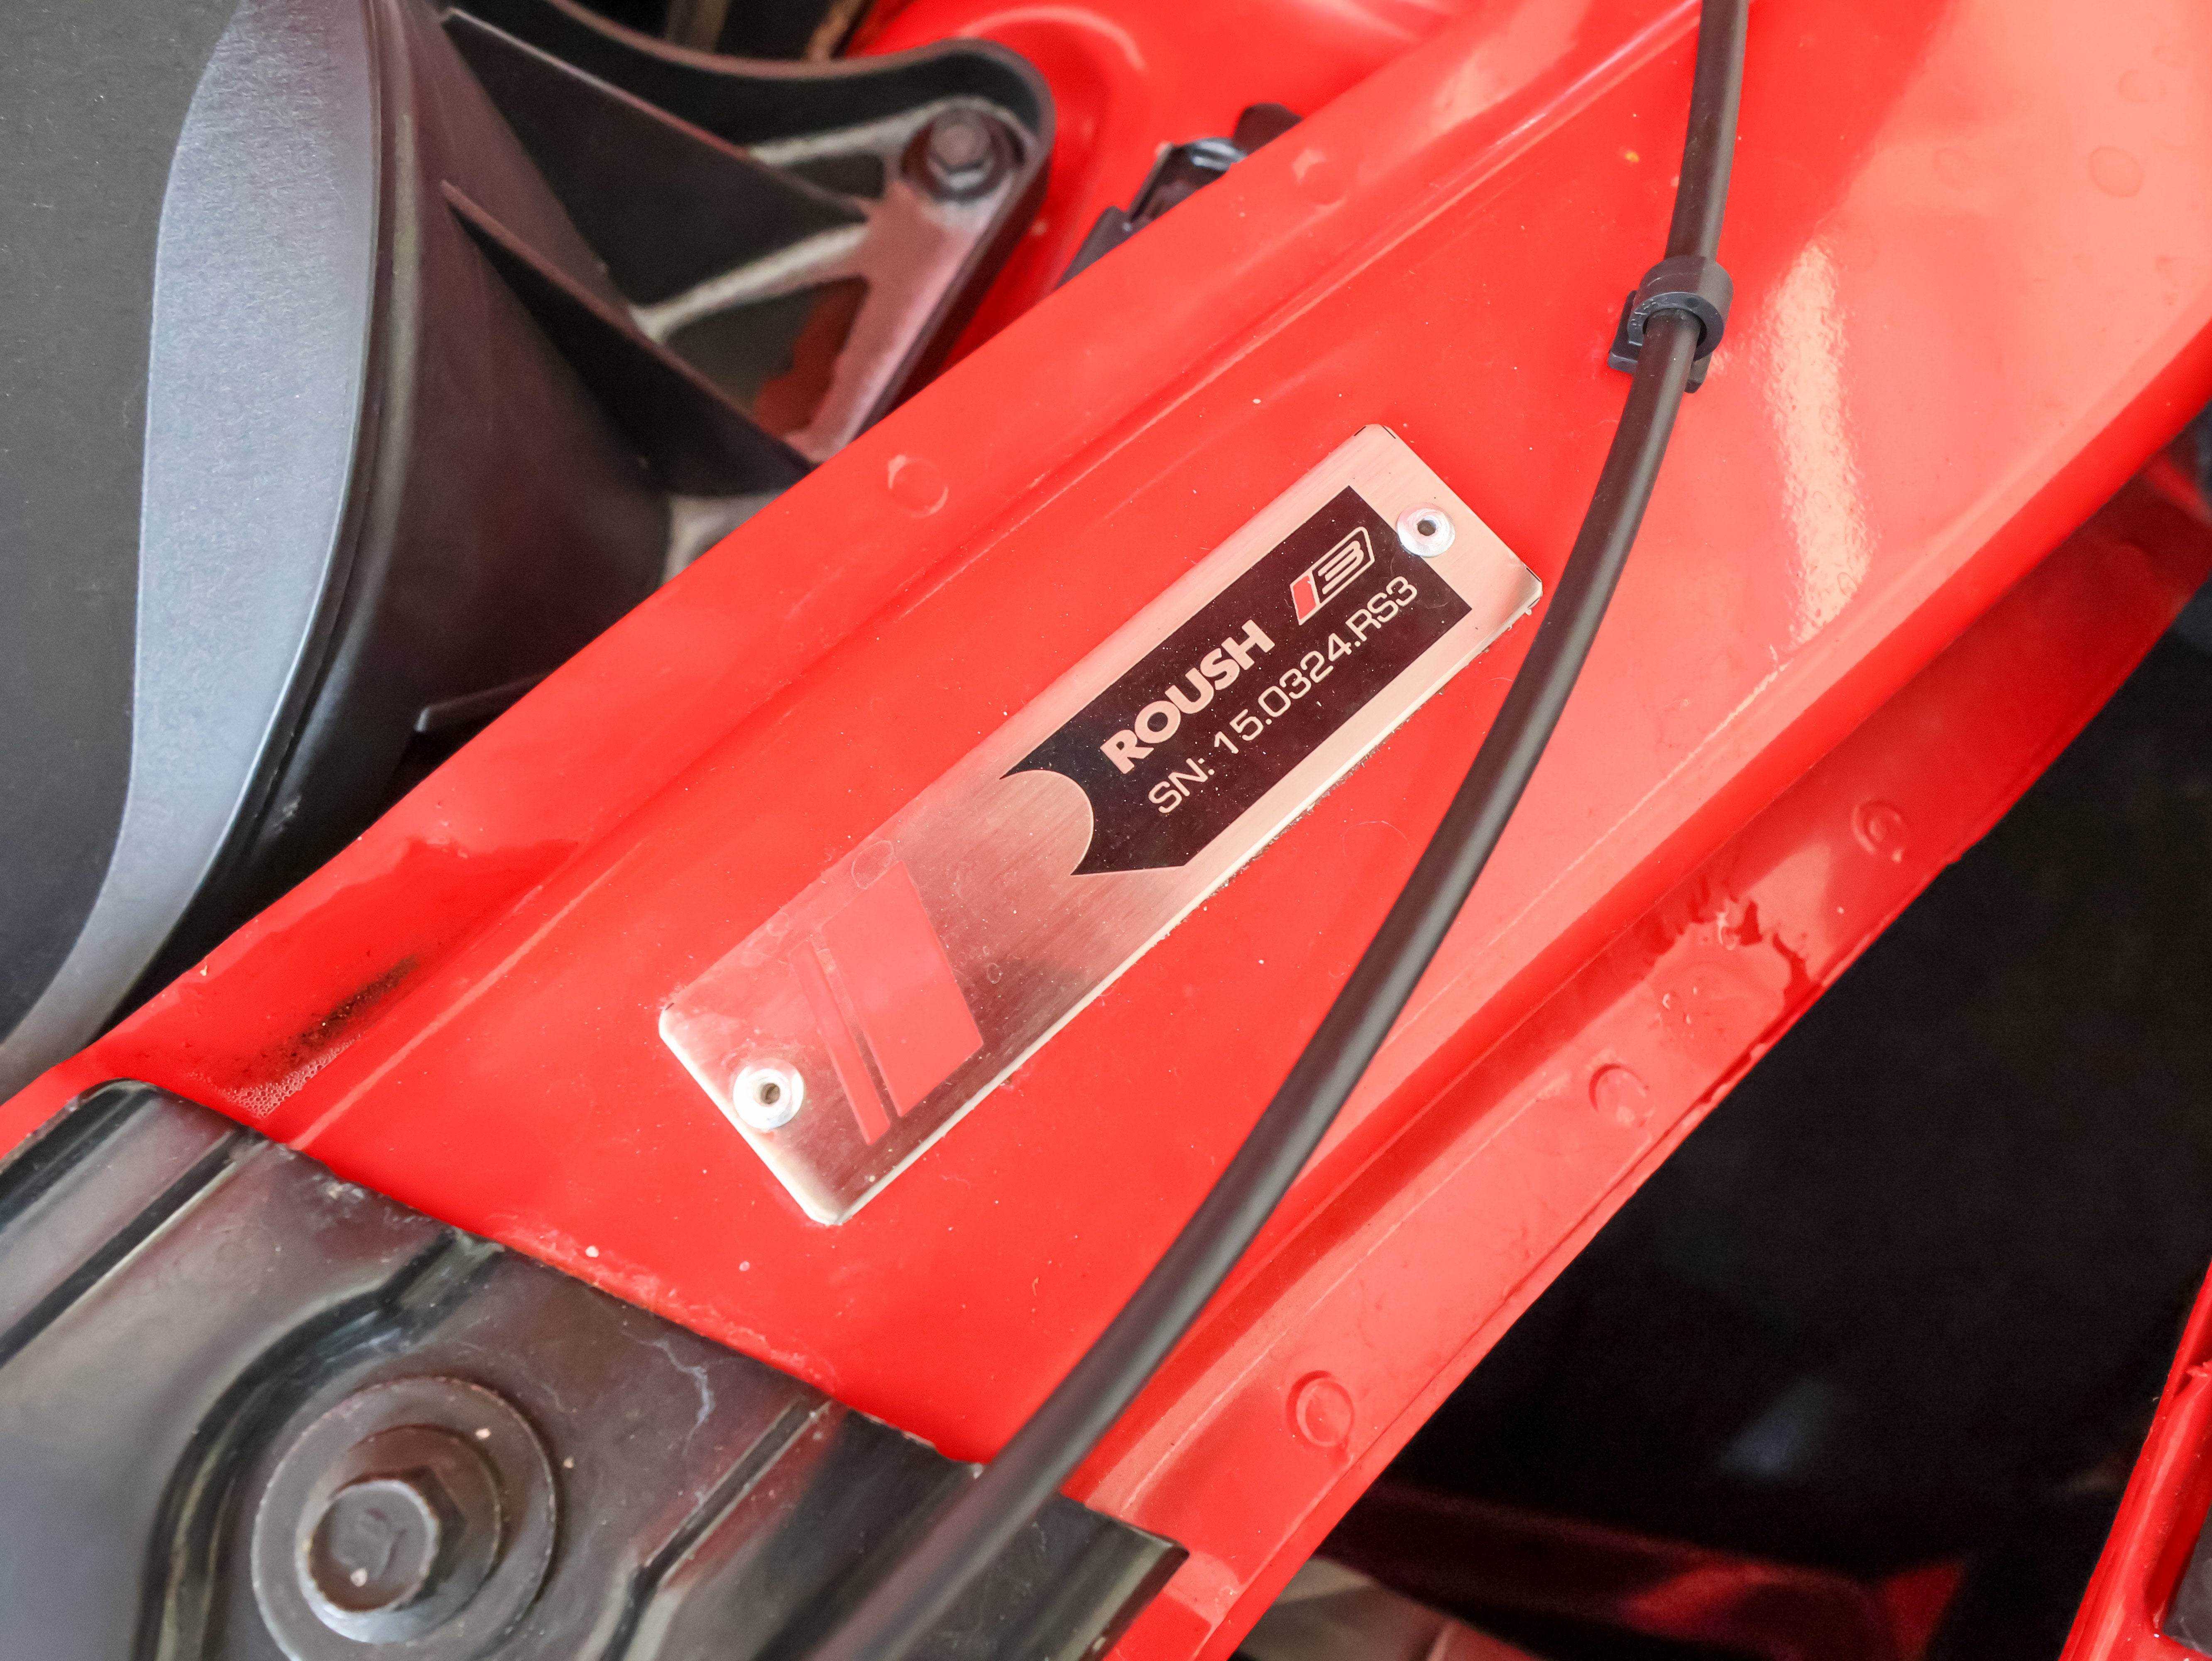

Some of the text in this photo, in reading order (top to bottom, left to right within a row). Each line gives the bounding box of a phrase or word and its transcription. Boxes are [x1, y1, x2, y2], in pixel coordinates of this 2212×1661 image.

[1100, 619, 1275, 774] ROUSH
[1148, 576, 1418, 814] SN: 15.0324.RS3
